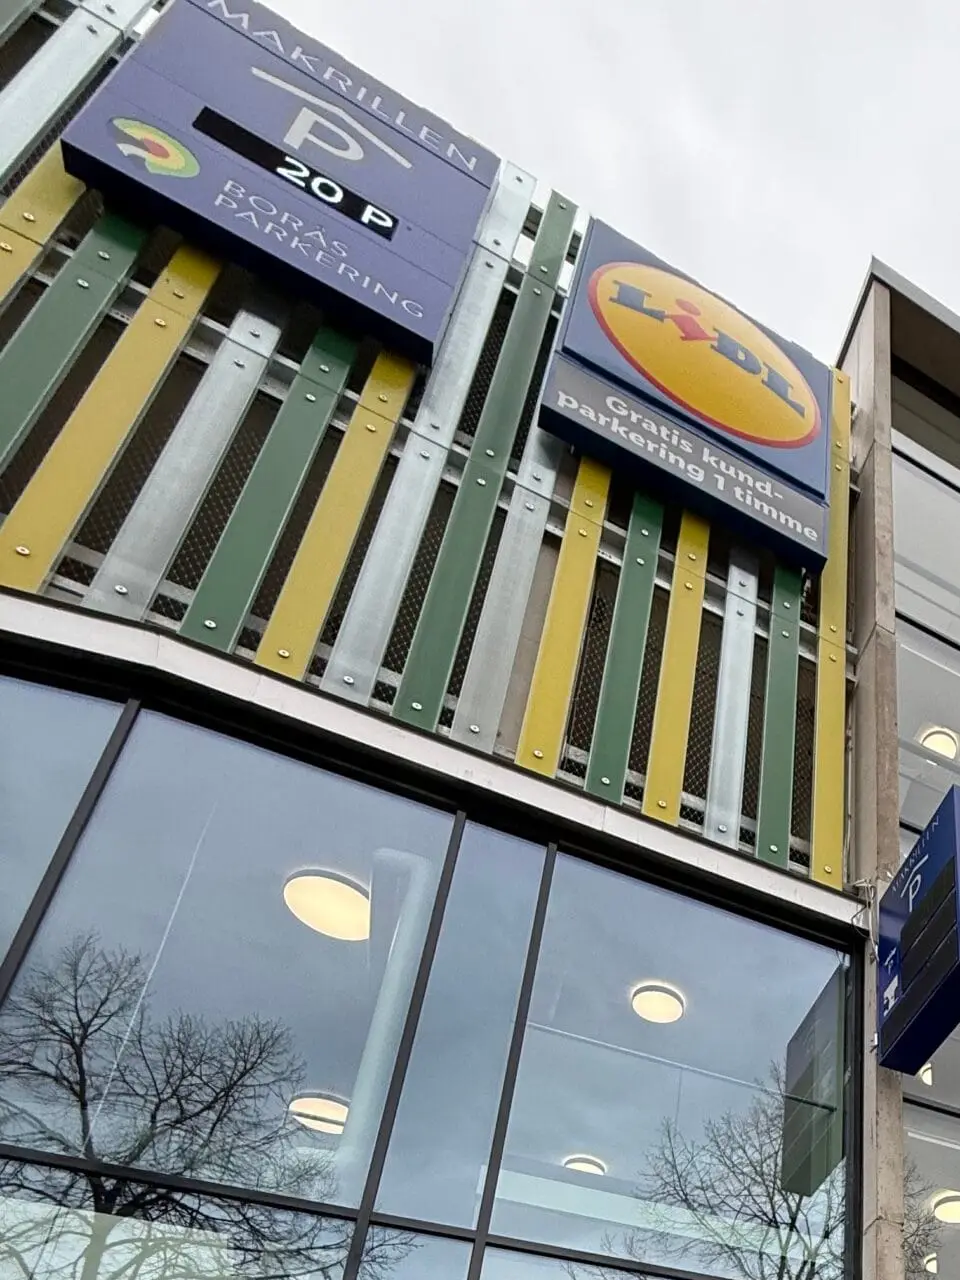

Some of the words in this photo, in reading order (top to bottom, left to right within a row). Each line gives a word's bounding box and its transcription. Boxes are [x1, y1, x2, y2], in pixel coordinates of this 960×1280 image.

[208, 0, 477, 171] MAKRILLEN
[283, 107, 364, 161] P
[223, 180, 348, 258] BORÅS
[276, 155, 344, 204] 20
[361, 205, 393, 228] P
[214, 193, 424, 318] PARKERING
[557, 391, 705, 483] parkering
[714, 474, 727, 491] 1
[733, 484, 819, 542] timme
[605, 395, 694, 454] Gratis
[702, 447, 784, 499] kund-
